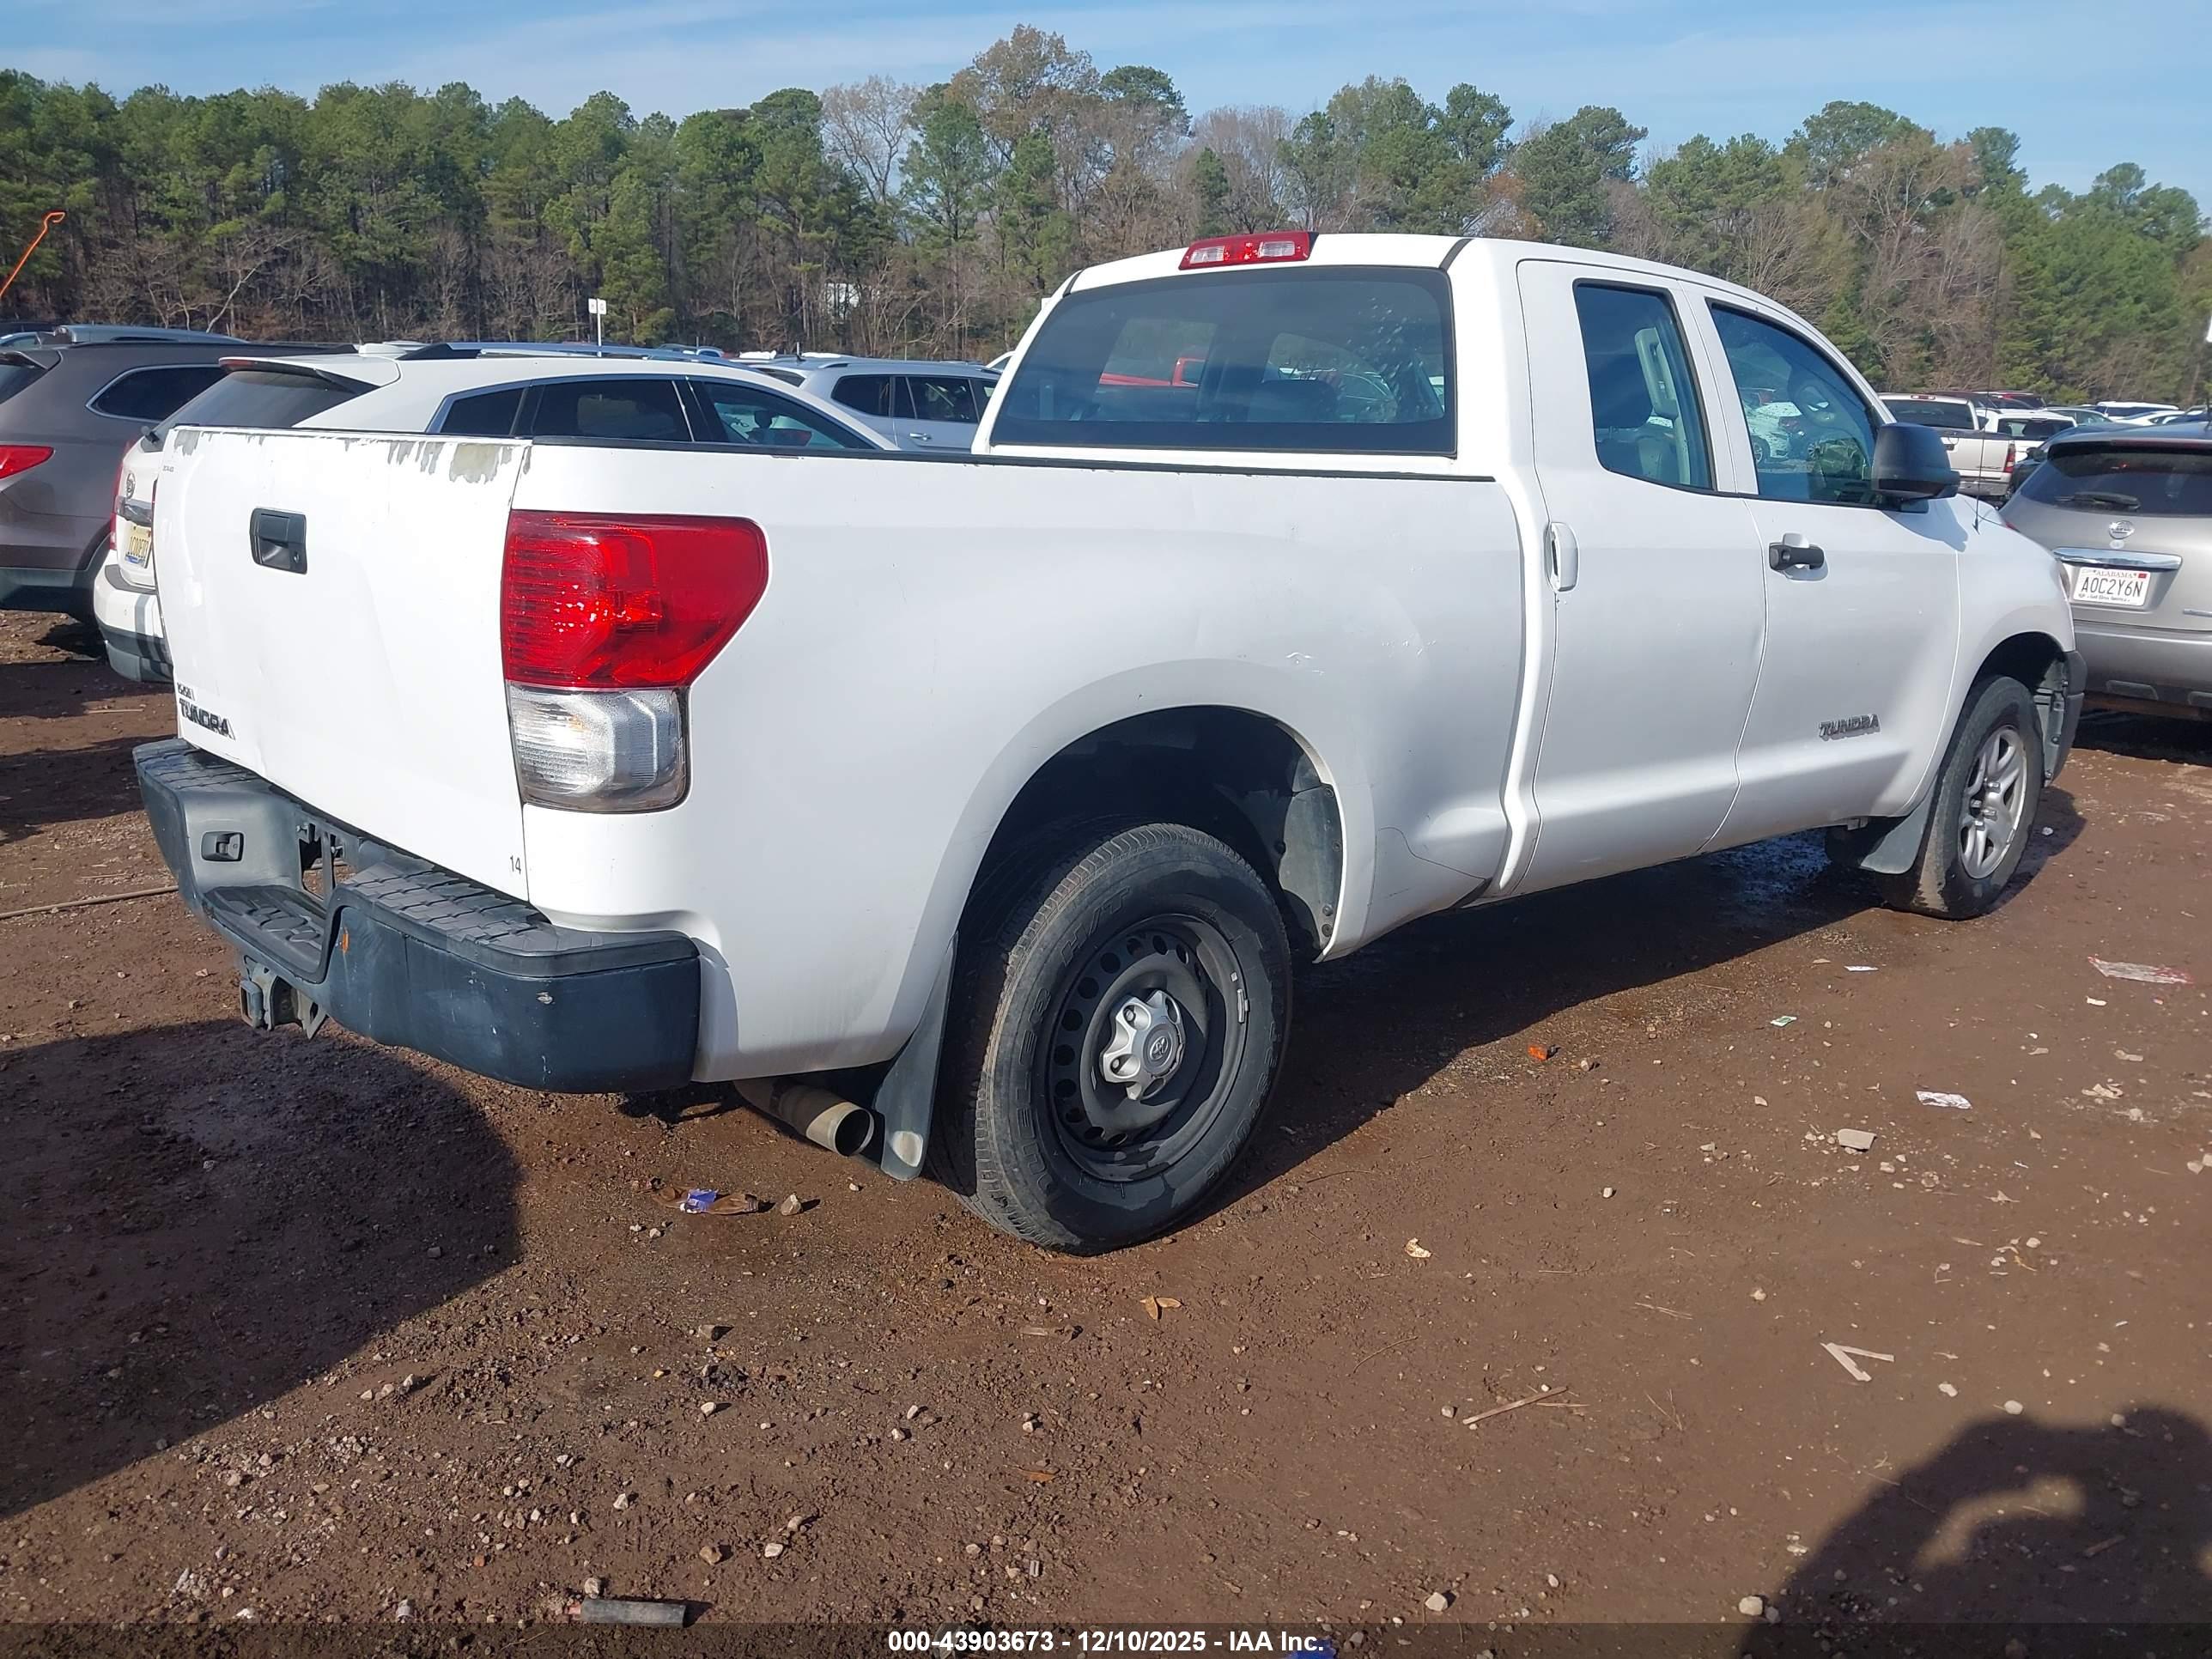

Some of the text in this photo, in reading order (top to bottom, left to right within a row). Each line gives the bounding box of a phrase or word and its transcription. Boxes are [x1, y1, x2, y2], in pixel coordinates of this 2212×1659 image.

[2096, 570, 2135, 579] ALABAMA
[179, 697, 236, 741] TUNDRA
[1819, 714, 1881, 741] TUNDRA
[509, 854, 522, 875] 14
